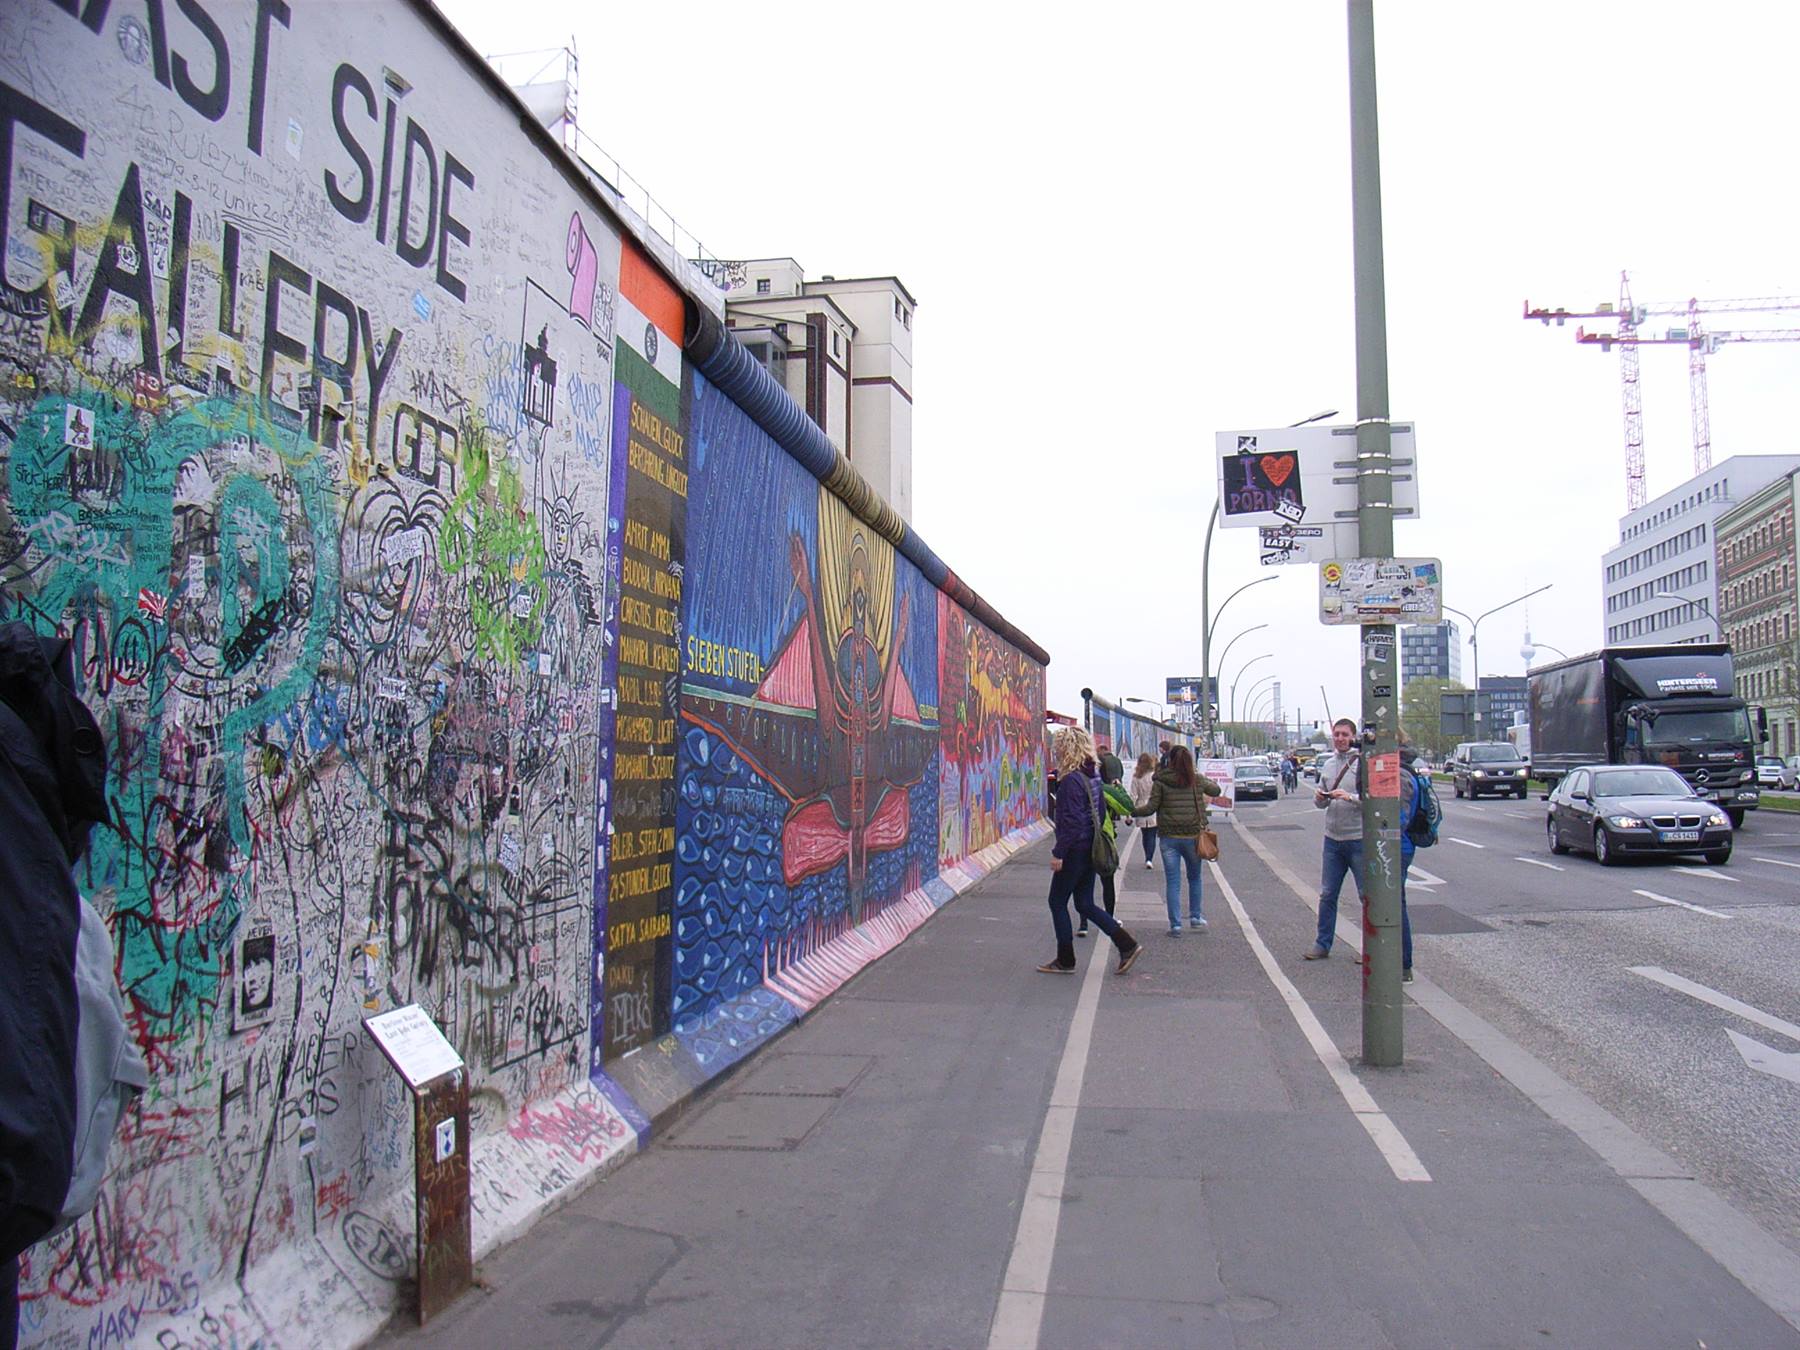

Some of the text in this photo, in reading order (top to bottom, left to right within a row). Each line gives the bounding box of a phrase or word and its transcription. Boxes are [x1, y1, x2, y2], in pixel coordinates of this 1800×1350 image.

[324, 62, 475, 304] SIDE
[1265, 539, 1291, 548] EASY
[688, 635, 725, 677] SIEBEN
[609, 923, 636, 951] SATYA
